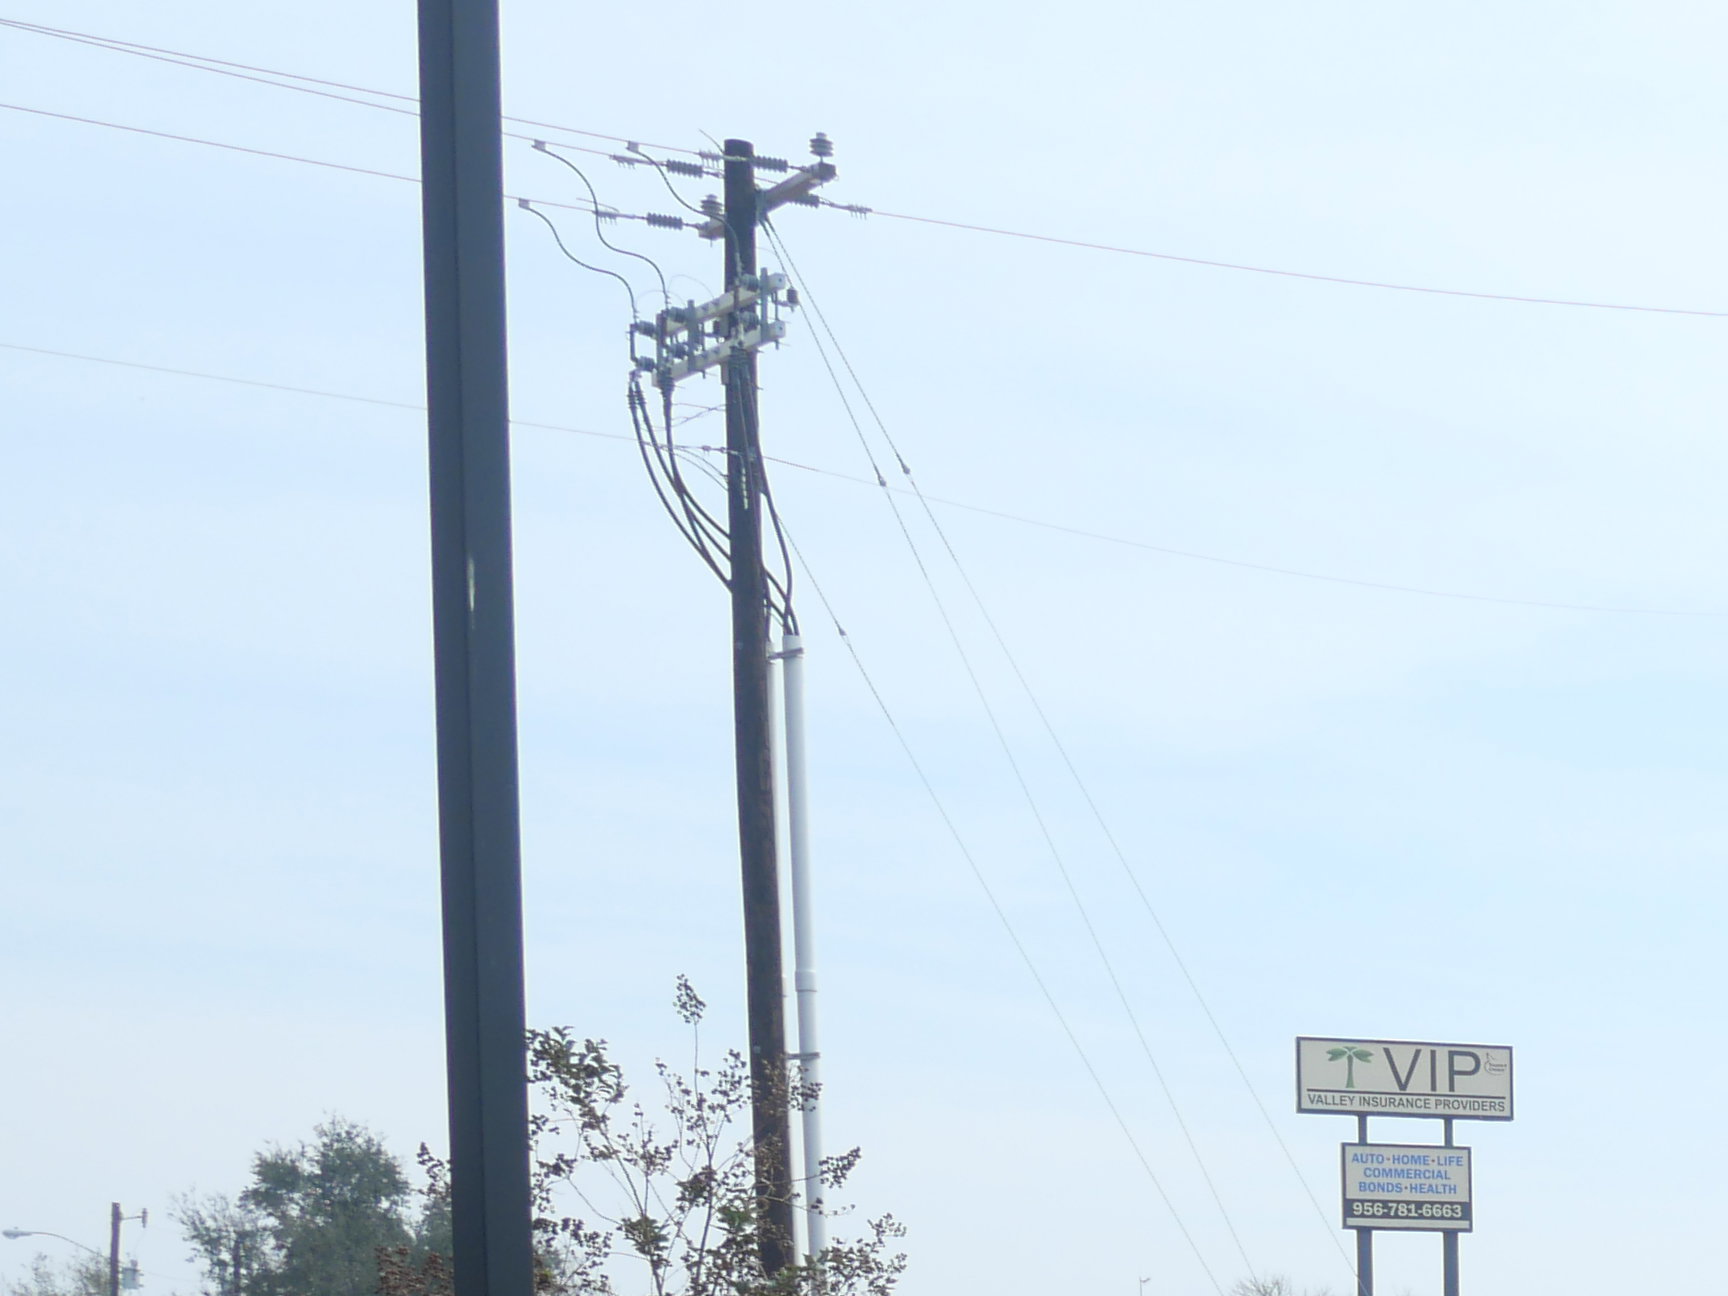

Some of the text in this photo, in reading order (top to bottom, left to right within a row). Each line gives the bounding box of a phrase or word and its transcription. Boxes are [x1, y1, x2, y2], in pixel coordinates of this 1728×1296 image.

[1382, 1047, 1482, 1093] VIP
[1307, 1093, 1506, 1112] VALLEY INSURANCE PROVIDERS
[1351, 1153, 1464, 1167] AUTO HOME LIFE
[1363, 1167, 1452, 1180] COMMERCIAL
[1358, 1181, 1457, 1195] BONDS HEALTH
[1352, 1202, 1463, 1218] 956-781-6663
